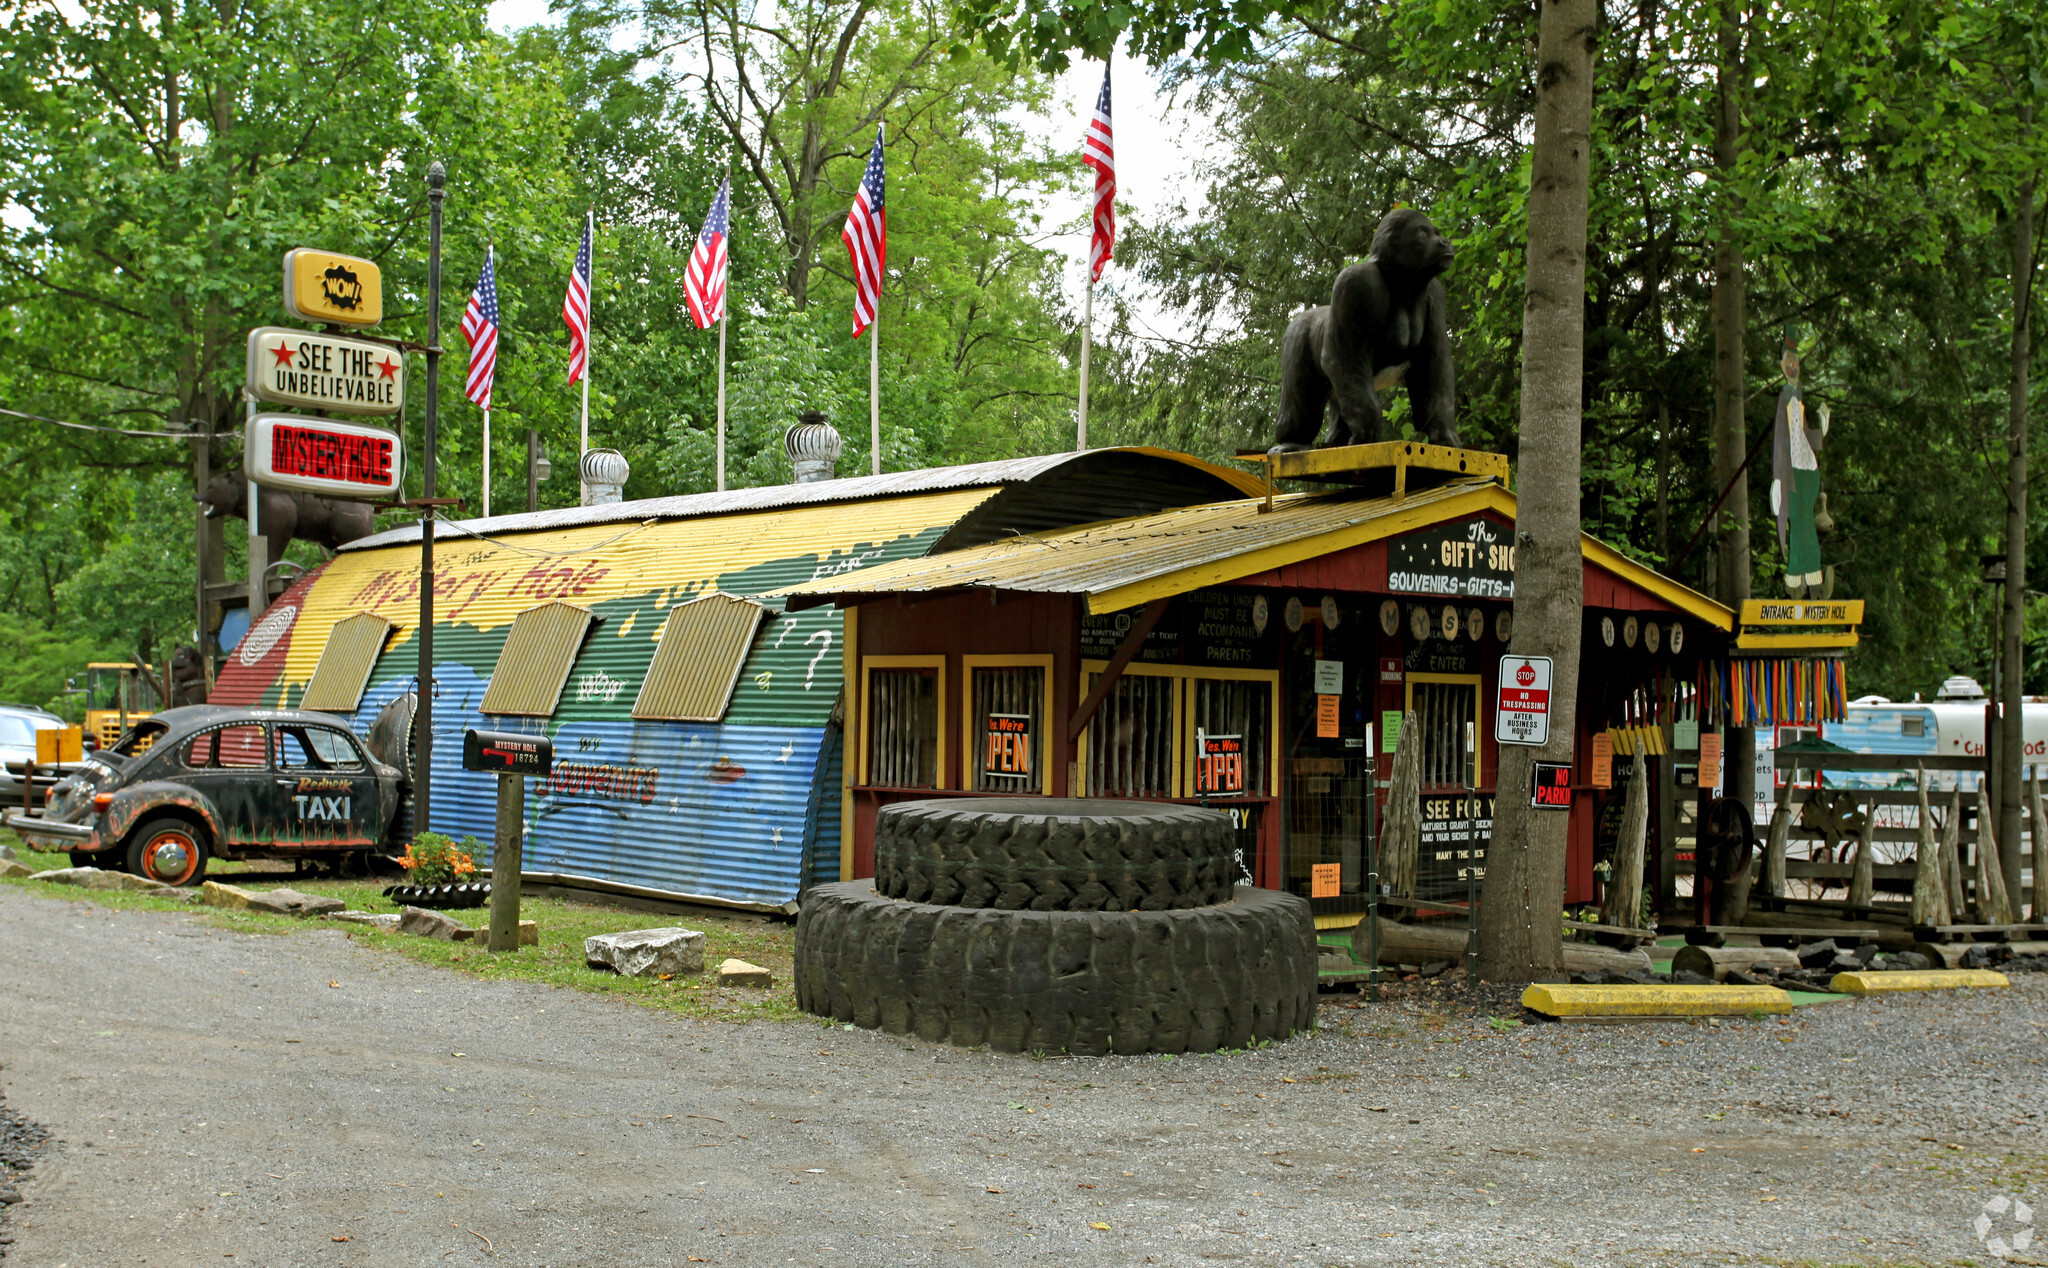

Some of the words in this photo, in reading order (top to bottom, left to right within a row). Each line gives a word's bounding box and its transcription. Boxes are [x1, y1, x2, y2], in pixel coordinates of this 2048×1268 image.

[326, 277, 362, 305] WOW!
[298, 341, 332, 374] SEE
[339, 347, 375, 378] THE
[276, 370, 394, 404] UNBELIEVABLE
[274, 427, 347, 478] MYSTERY
[349, 436, 390, 483] HOLE
[1467, 520, 1497, 543] The
[1441, 540, 1476, 569] GIFT
[507, 557, 611, 599] Hole
[1187, 591, 1229, 605] CHILDREN
[1204, 607, 1230, 621] MUST
[1236, 609, 1248, 623] BE
[1760, 605, 1794, 620] ENTRANCE
[1795, 605, 1804, 620] TO
[1804, 605, 1831, 620] MYSTERY
[1831, 605, 1846, 620] HOLE
[1082, 615, 1111, 629] EVERY
[1206, 646, 1252, 662] PARENTS
[1387, 660, 1395, 671] NO
[1429, 655, 1466, 672] ENTER
[1381, 671, 1402, 681] SMOKING
[1517, 672, 1535, 681] STOP
[1520, 692, 1529, 700] NO
[1502, 700, 1546, 710] TRESPASSING
[1507, 719, 1538, 729] BUSINESS
[1513, 713, 1533, 721] AFTER
[999, 718, 1025, 733] We're
[1511, 727, 1532, 736] HOURS
[494, 741, 522, 751] MYSTERY
[522, 743, 537, 752] HOLE
[1197, 752, 1242, 792] OPEN
[1555, 768, 1569, 786] NO
[297, 777, 354, 794] Redneck
[293, 795, 351, 820] TAXI
[1426, 799, 1450, 819] SEE
[1421, 822, 1447, 831] NATURES
[1421, 832, 1434, 842] AND
[1435, 832, 1450, 842] YOUR
[1435, 850, 1453, 861] MANY
[1457, 868, 1468, 878] WE
